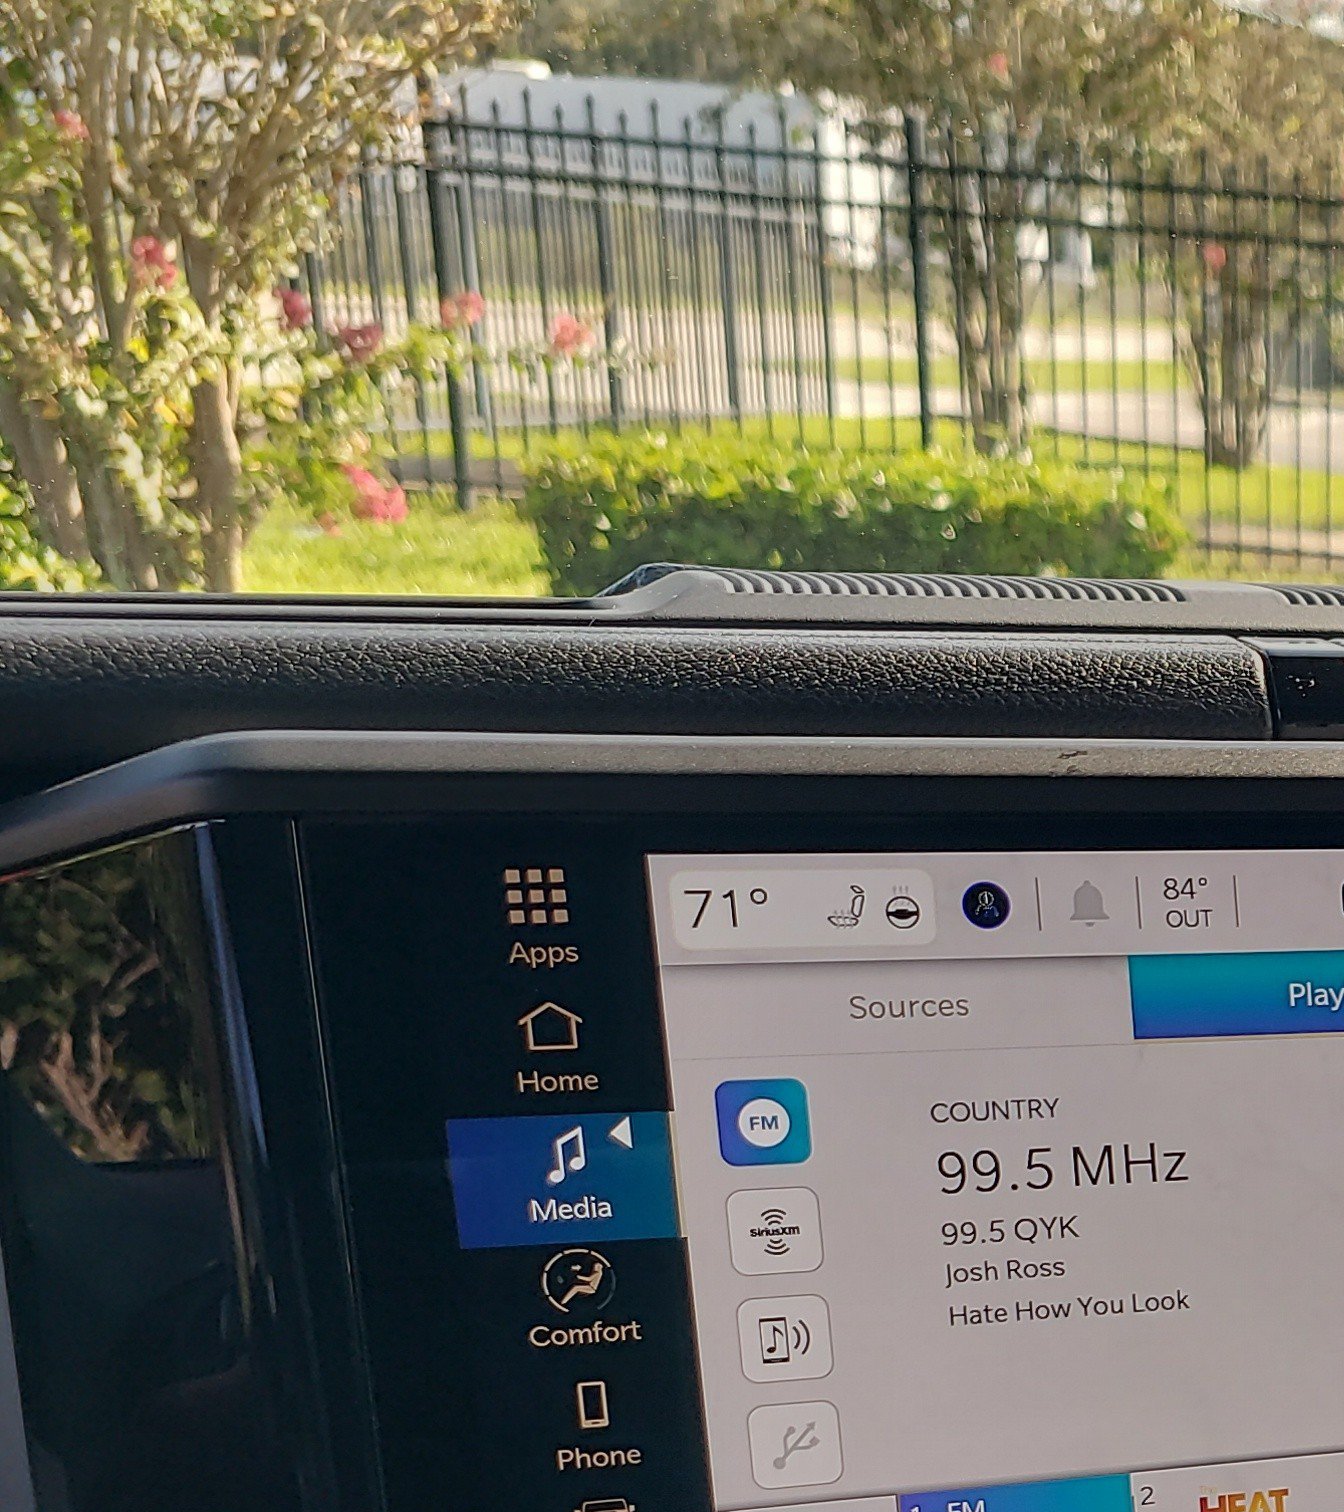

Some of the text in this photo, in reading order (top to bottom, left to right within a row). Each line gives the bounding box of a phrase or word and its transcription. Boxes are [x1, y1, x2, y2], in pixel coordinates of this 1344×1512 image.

[1162, 876, 1209, 901] 84°
[683, 887, 769, 929] 71°
[1165, 909, 1214, 929] OUT
[508, 941, 580, 969] Apps
[848, 995, 970, 1020] Sources
[516, 1070, 600, 1094] Home
[749, 1115, 780, 1132] FM
[929, 1097, 1061, 1124] COUNTRY
[936, 1142, 1190, 1195] 99.5 MHz
[529, 1195, 614, 1224] Media
[940, 1214, 1081, 1247] 99.5 QYK
[944, 1258, 1067, 1289] Josh Ross
[949, 1288, 1191, 1327] Hate How You Look
[528, 1319, 643, 1348] Comfort
[556, 1446, 642, 1471] Phone
[1139, 1485, 1156, 1506] 2
